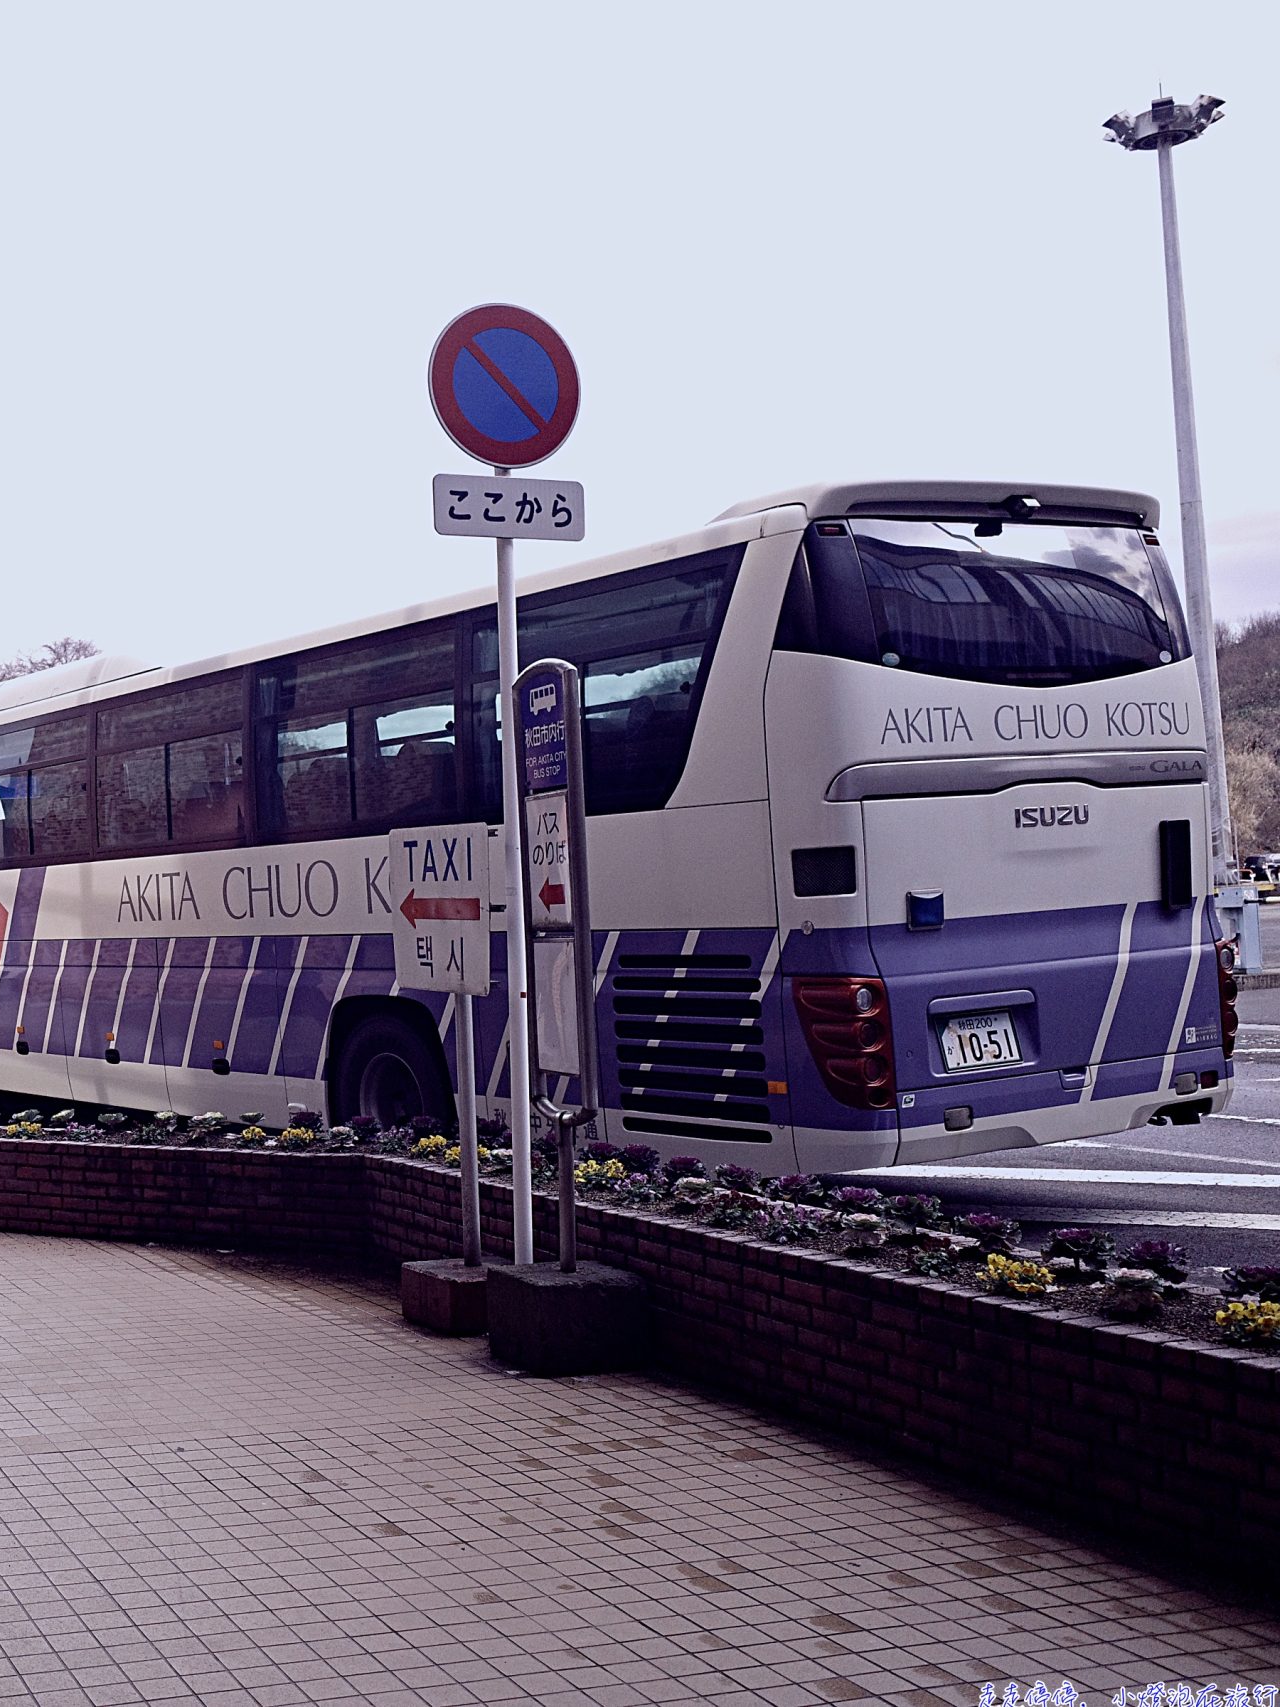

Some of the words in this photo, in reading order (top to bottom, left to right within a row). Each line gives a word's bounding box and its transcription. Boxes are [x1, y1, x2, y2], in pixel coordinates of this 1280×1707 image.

[448, 490, 573, 528] ここから
[524, 720, 566, 749] 秋田市内行
[881, 706, 974, 745] AKITA
[994, 703, 1089, 741] CHUO
[1105, 702, 1190, 737] KOTSU
[525, 756, 538, 768] FOR
[538, 753, 554, 766] AKITA
[533, 767, 545, 779] BUS
[545, 765, 561, 777] STOP
[1150, 759, 1203, 773] GALA
[536, 812, 560, 836] バス
[1014, 804, 1090, 828] ISUZU
[403, 837, 472, 882] TAXI
[532, 840, 567, 866] のりば
[117, 870, 200, 922] AKITA
[222, 859, 338, 918] CHUO
[364, 856, 392, 915] K
